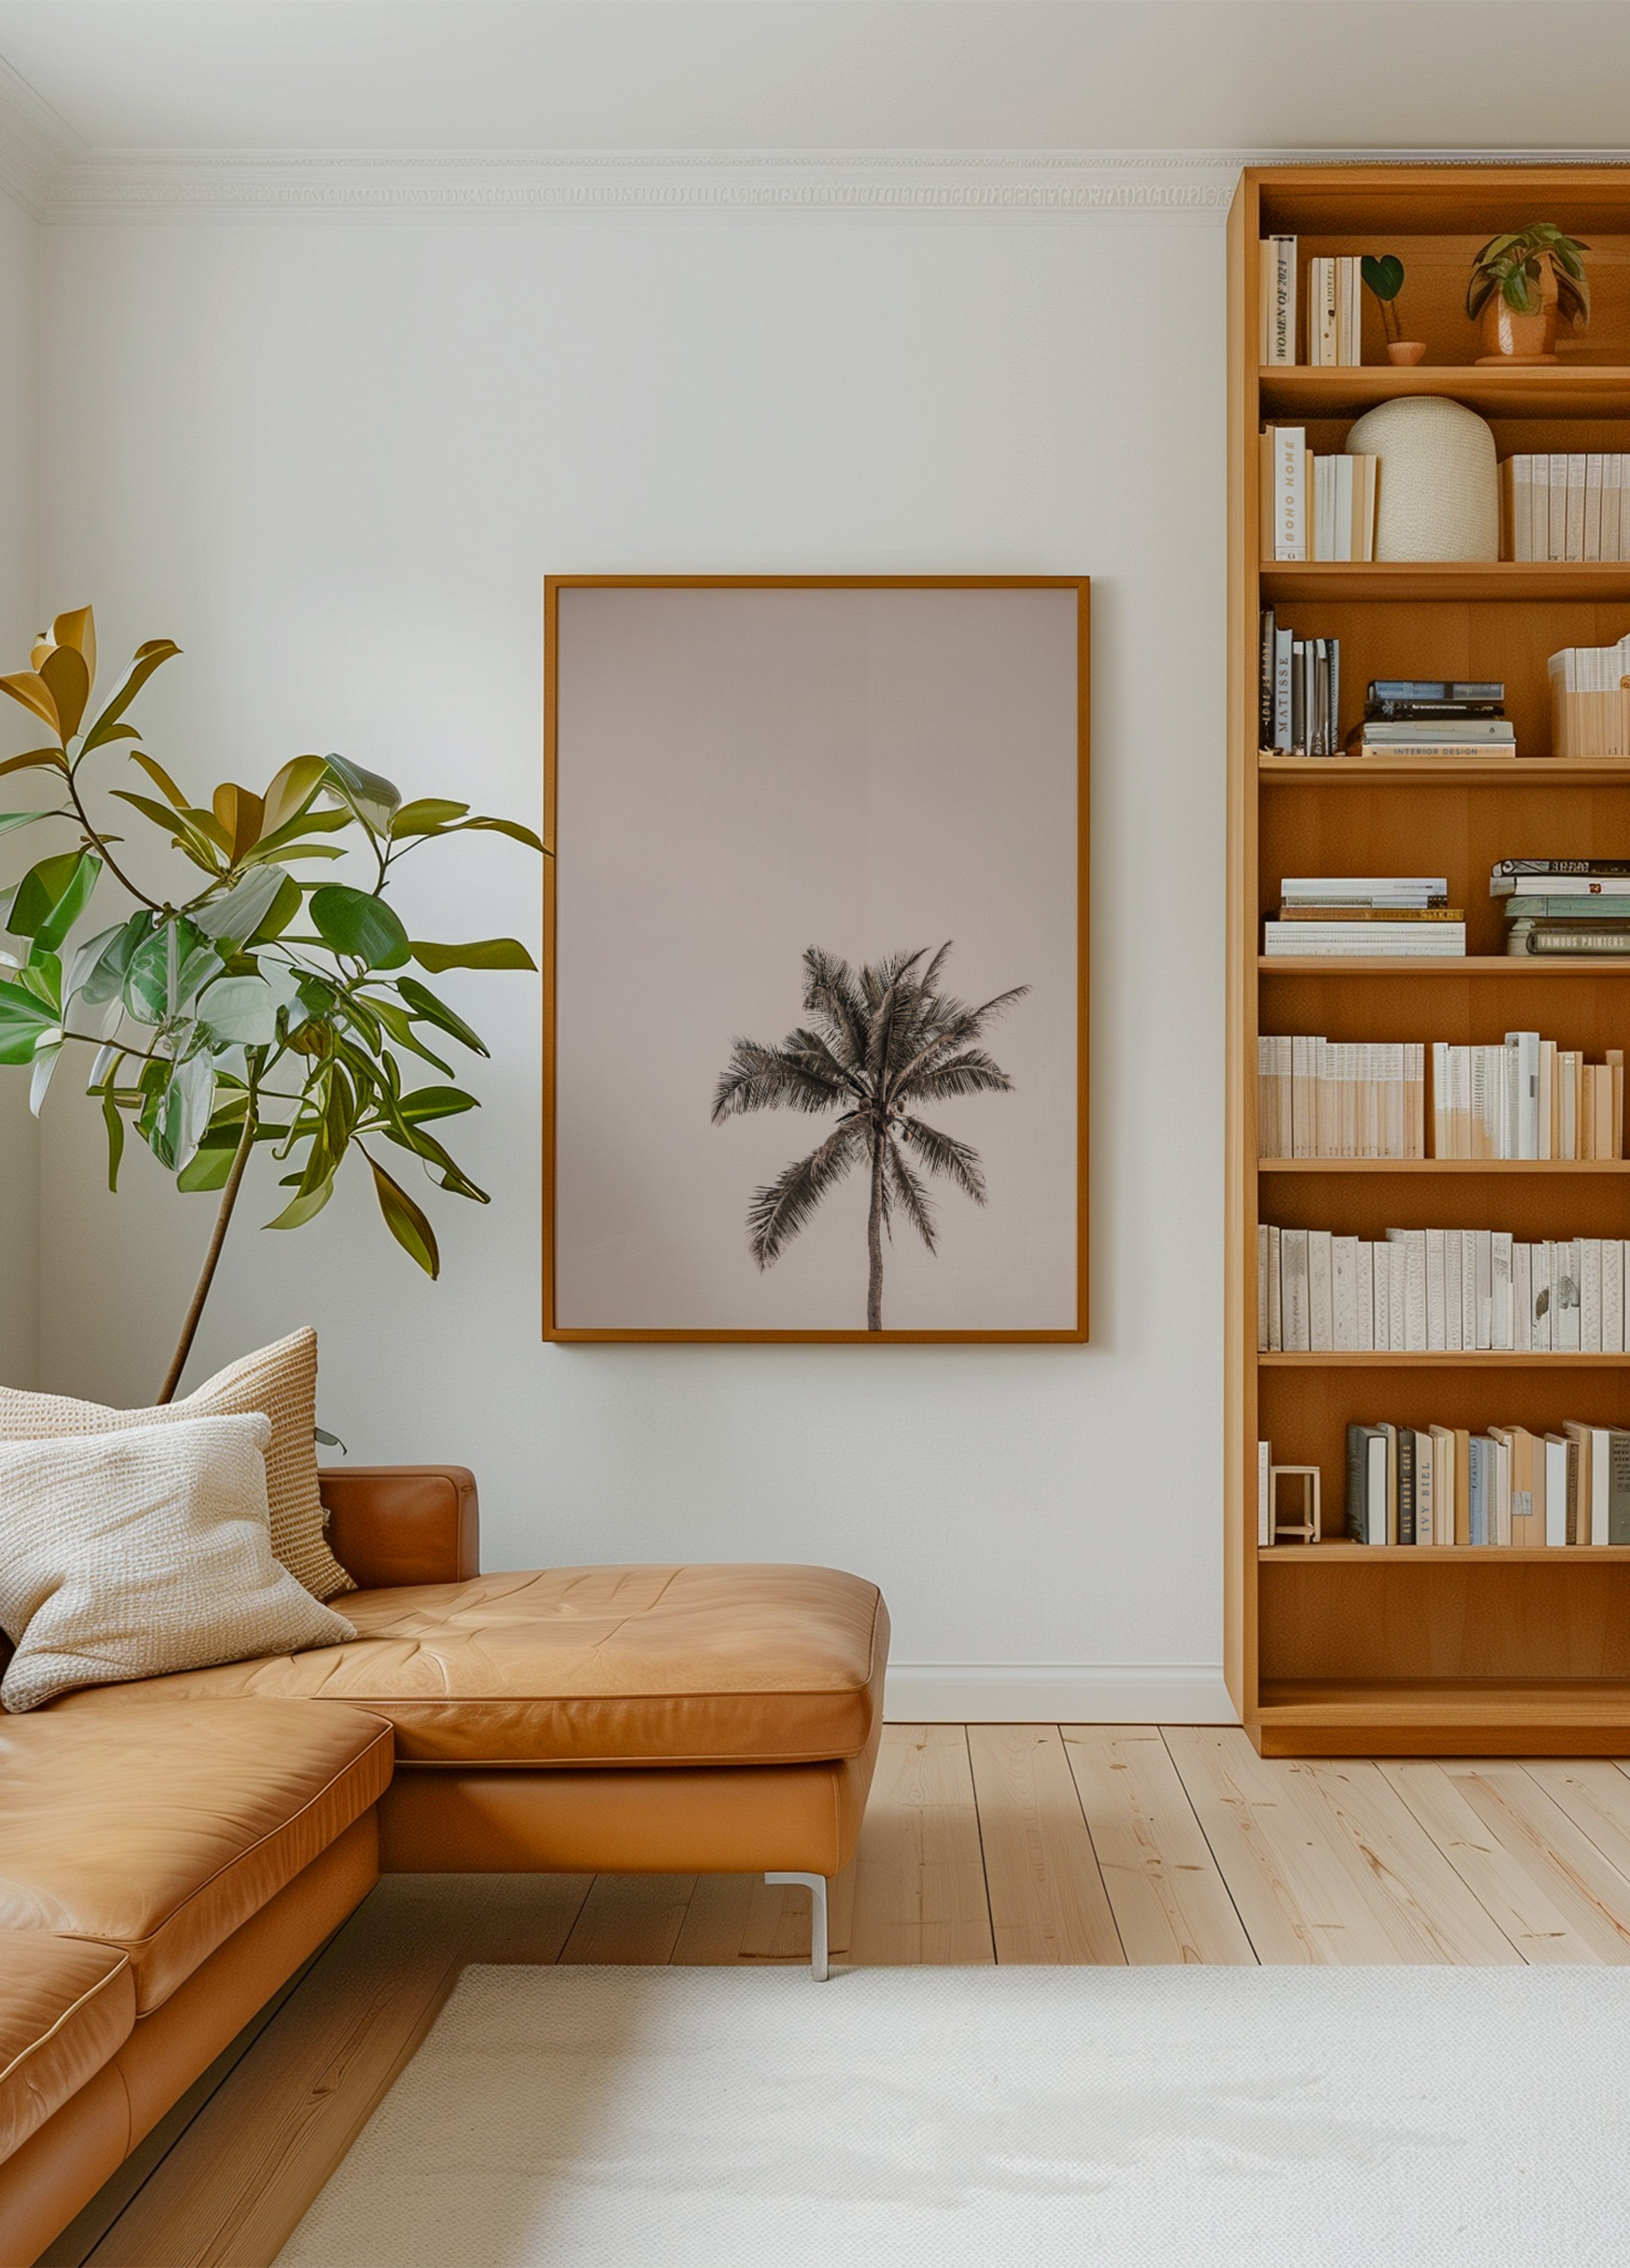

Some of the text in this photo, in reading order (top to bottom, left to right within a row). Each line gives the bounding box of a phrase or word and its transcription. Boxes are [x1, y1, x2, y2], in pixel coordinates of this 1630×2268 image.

[1277, 260, 1287, 358] WOMEN OF 2024
[1285, 441, 1294, 542] BOHO HOME
[1278, 657, 1288, 732] MATISSE
[1541, 937, 1624, 947] FAMOUS PAINTERS
[1402, 1445, 1411, 1533] ALL ABOUT CATS
[1421, 1463, 1430, 1532] IVY BIEL
